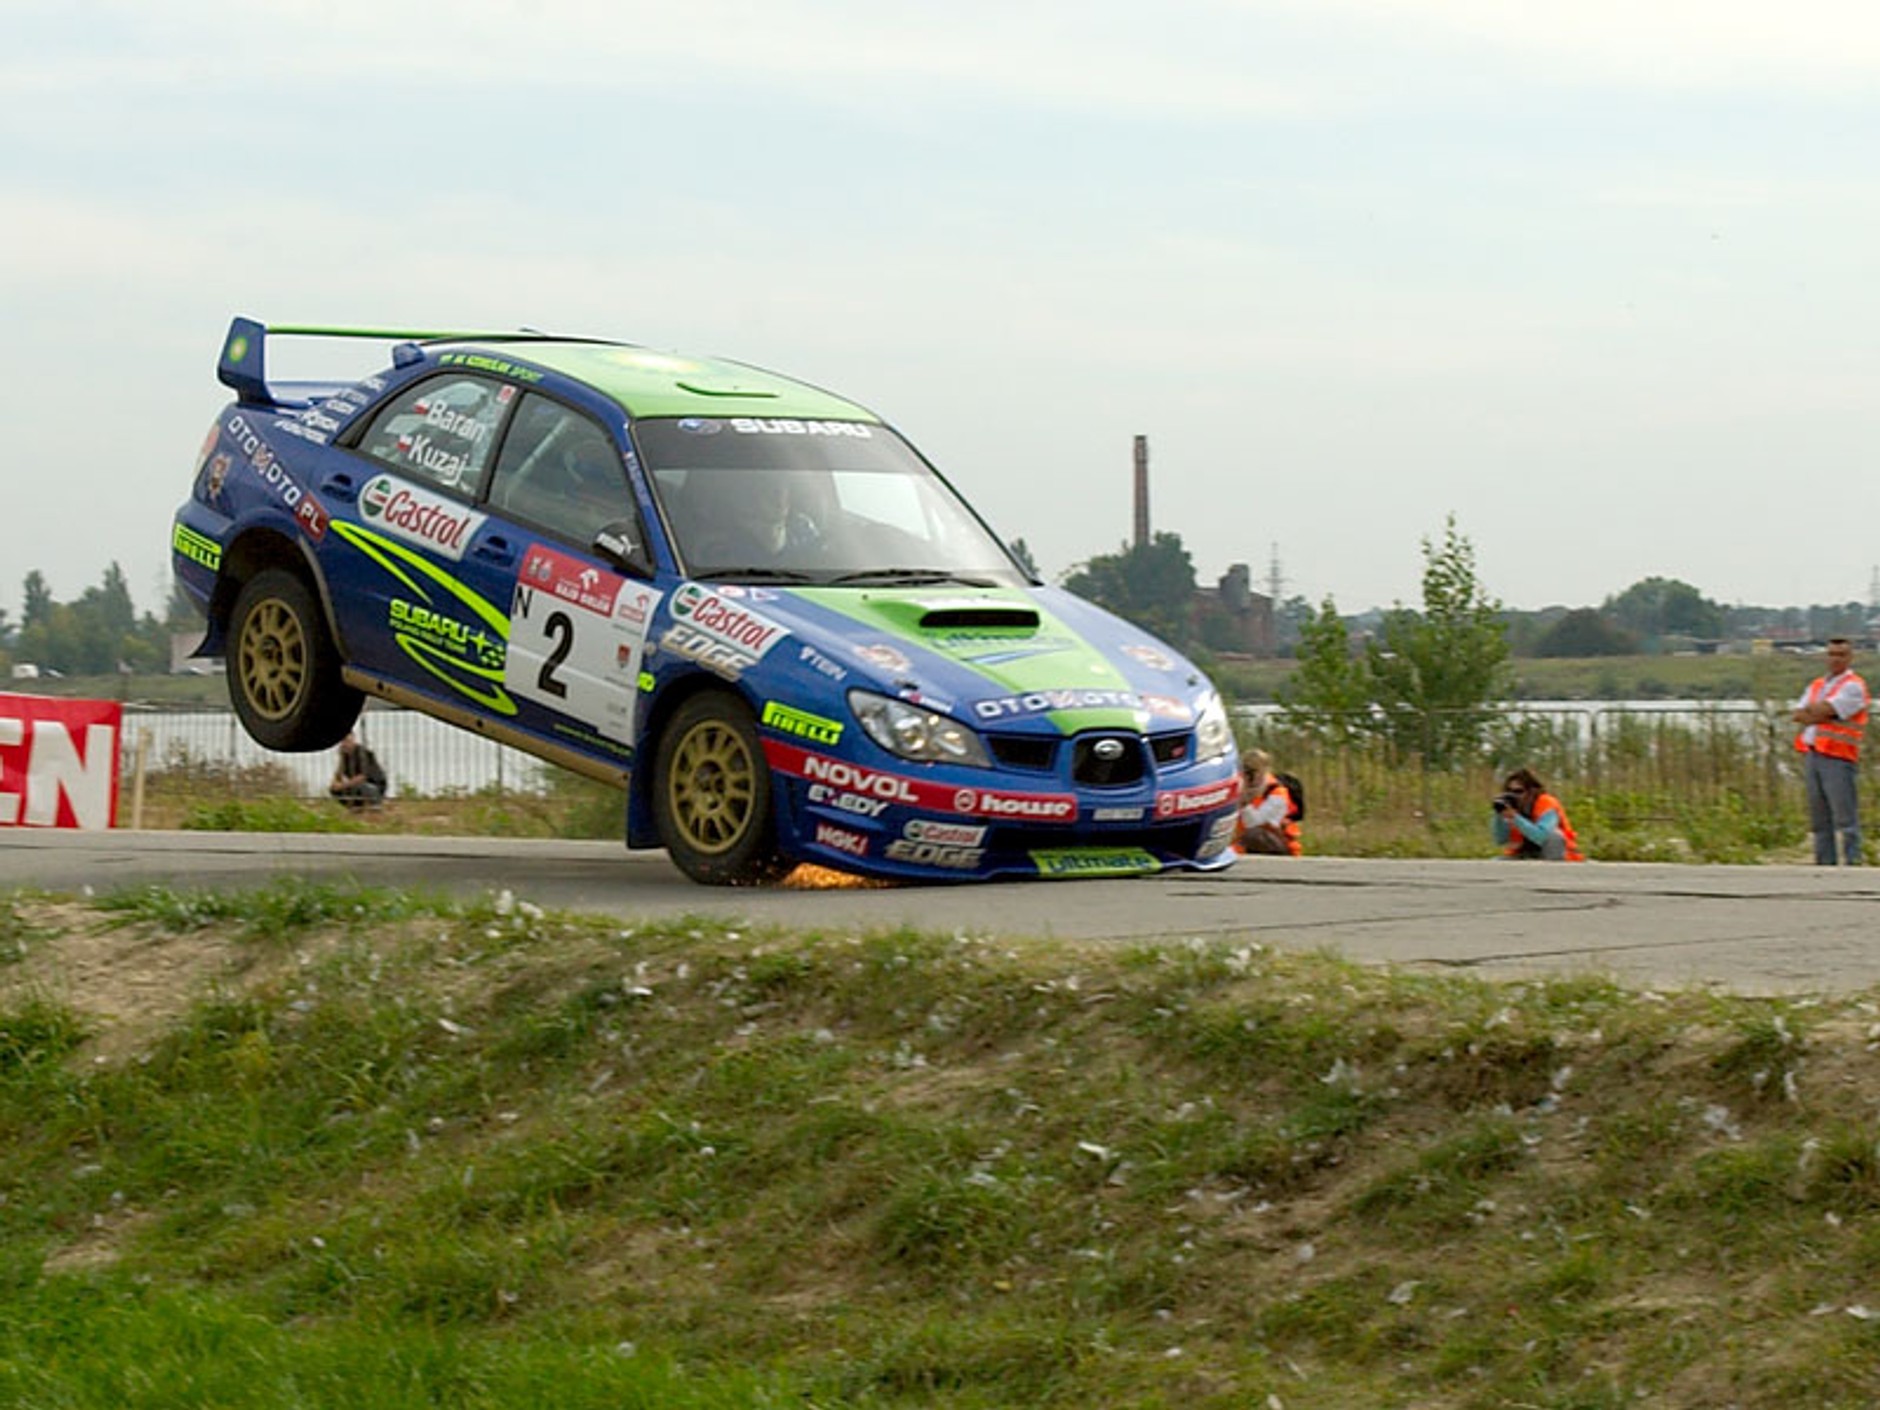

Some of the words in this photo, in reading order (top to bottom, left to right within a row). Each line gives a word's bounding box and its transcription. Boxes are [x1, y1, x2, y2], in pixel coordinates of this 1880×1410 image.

[426, 401, 486, 442] Baran
[730, 417, 873, 438] SUBARU
[407, 434, 469, 484] Kuzaj
[385, 490, 471, 550] Castrol
[389, 598, 470, 642] SUBARU
[513, 585, 533, 618] N
[694, 596, 777, 650] Castrol
[538, 610, 573, 698] 2
[661, 624, 760, 682] EDGE
[762, 701, 845, 746] PIRELLI
[804, 756, 919, 802] NOVOL
[808, 784, 889, 817] EXEDY
[884, 839, 986, 869] EDGE
